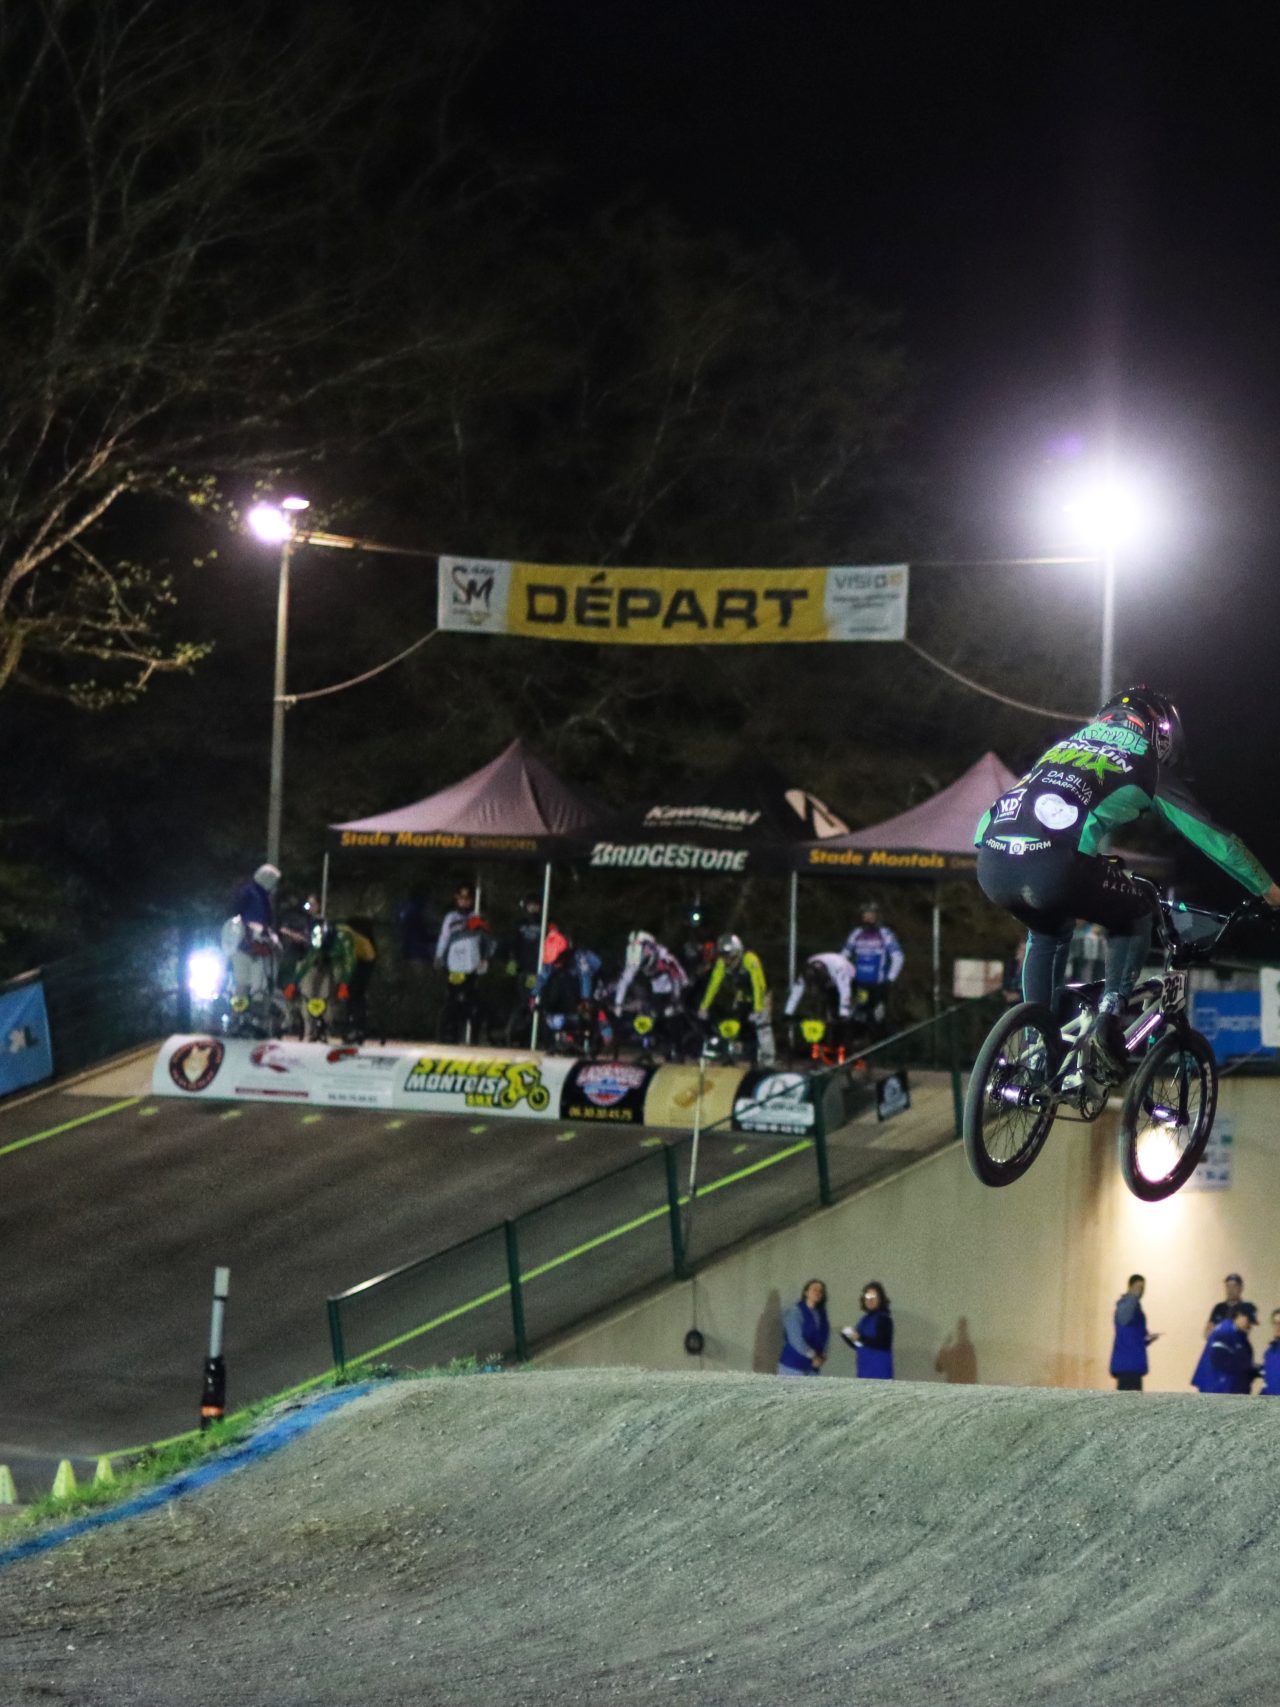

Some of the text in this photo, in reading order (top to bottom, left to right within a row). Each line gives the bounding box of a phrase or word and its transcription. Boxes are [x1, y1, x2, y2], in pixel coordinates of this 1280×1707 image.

[526, 572, 808, 630] DÉPART
[1058, 741, 1134, 773] ENGUIN
[1047, 770, 1093, 800] DA SILVA
[645, 804, 761, 825] Kawasaki
[340, 831, 391, 848] Stade
[395, 832, 465, 849] Montois
[590, 842, 749, 871] BRIDGESTONE
[809, 848, 864, 866] Stade
[868, 850, 945, 869] Montois
